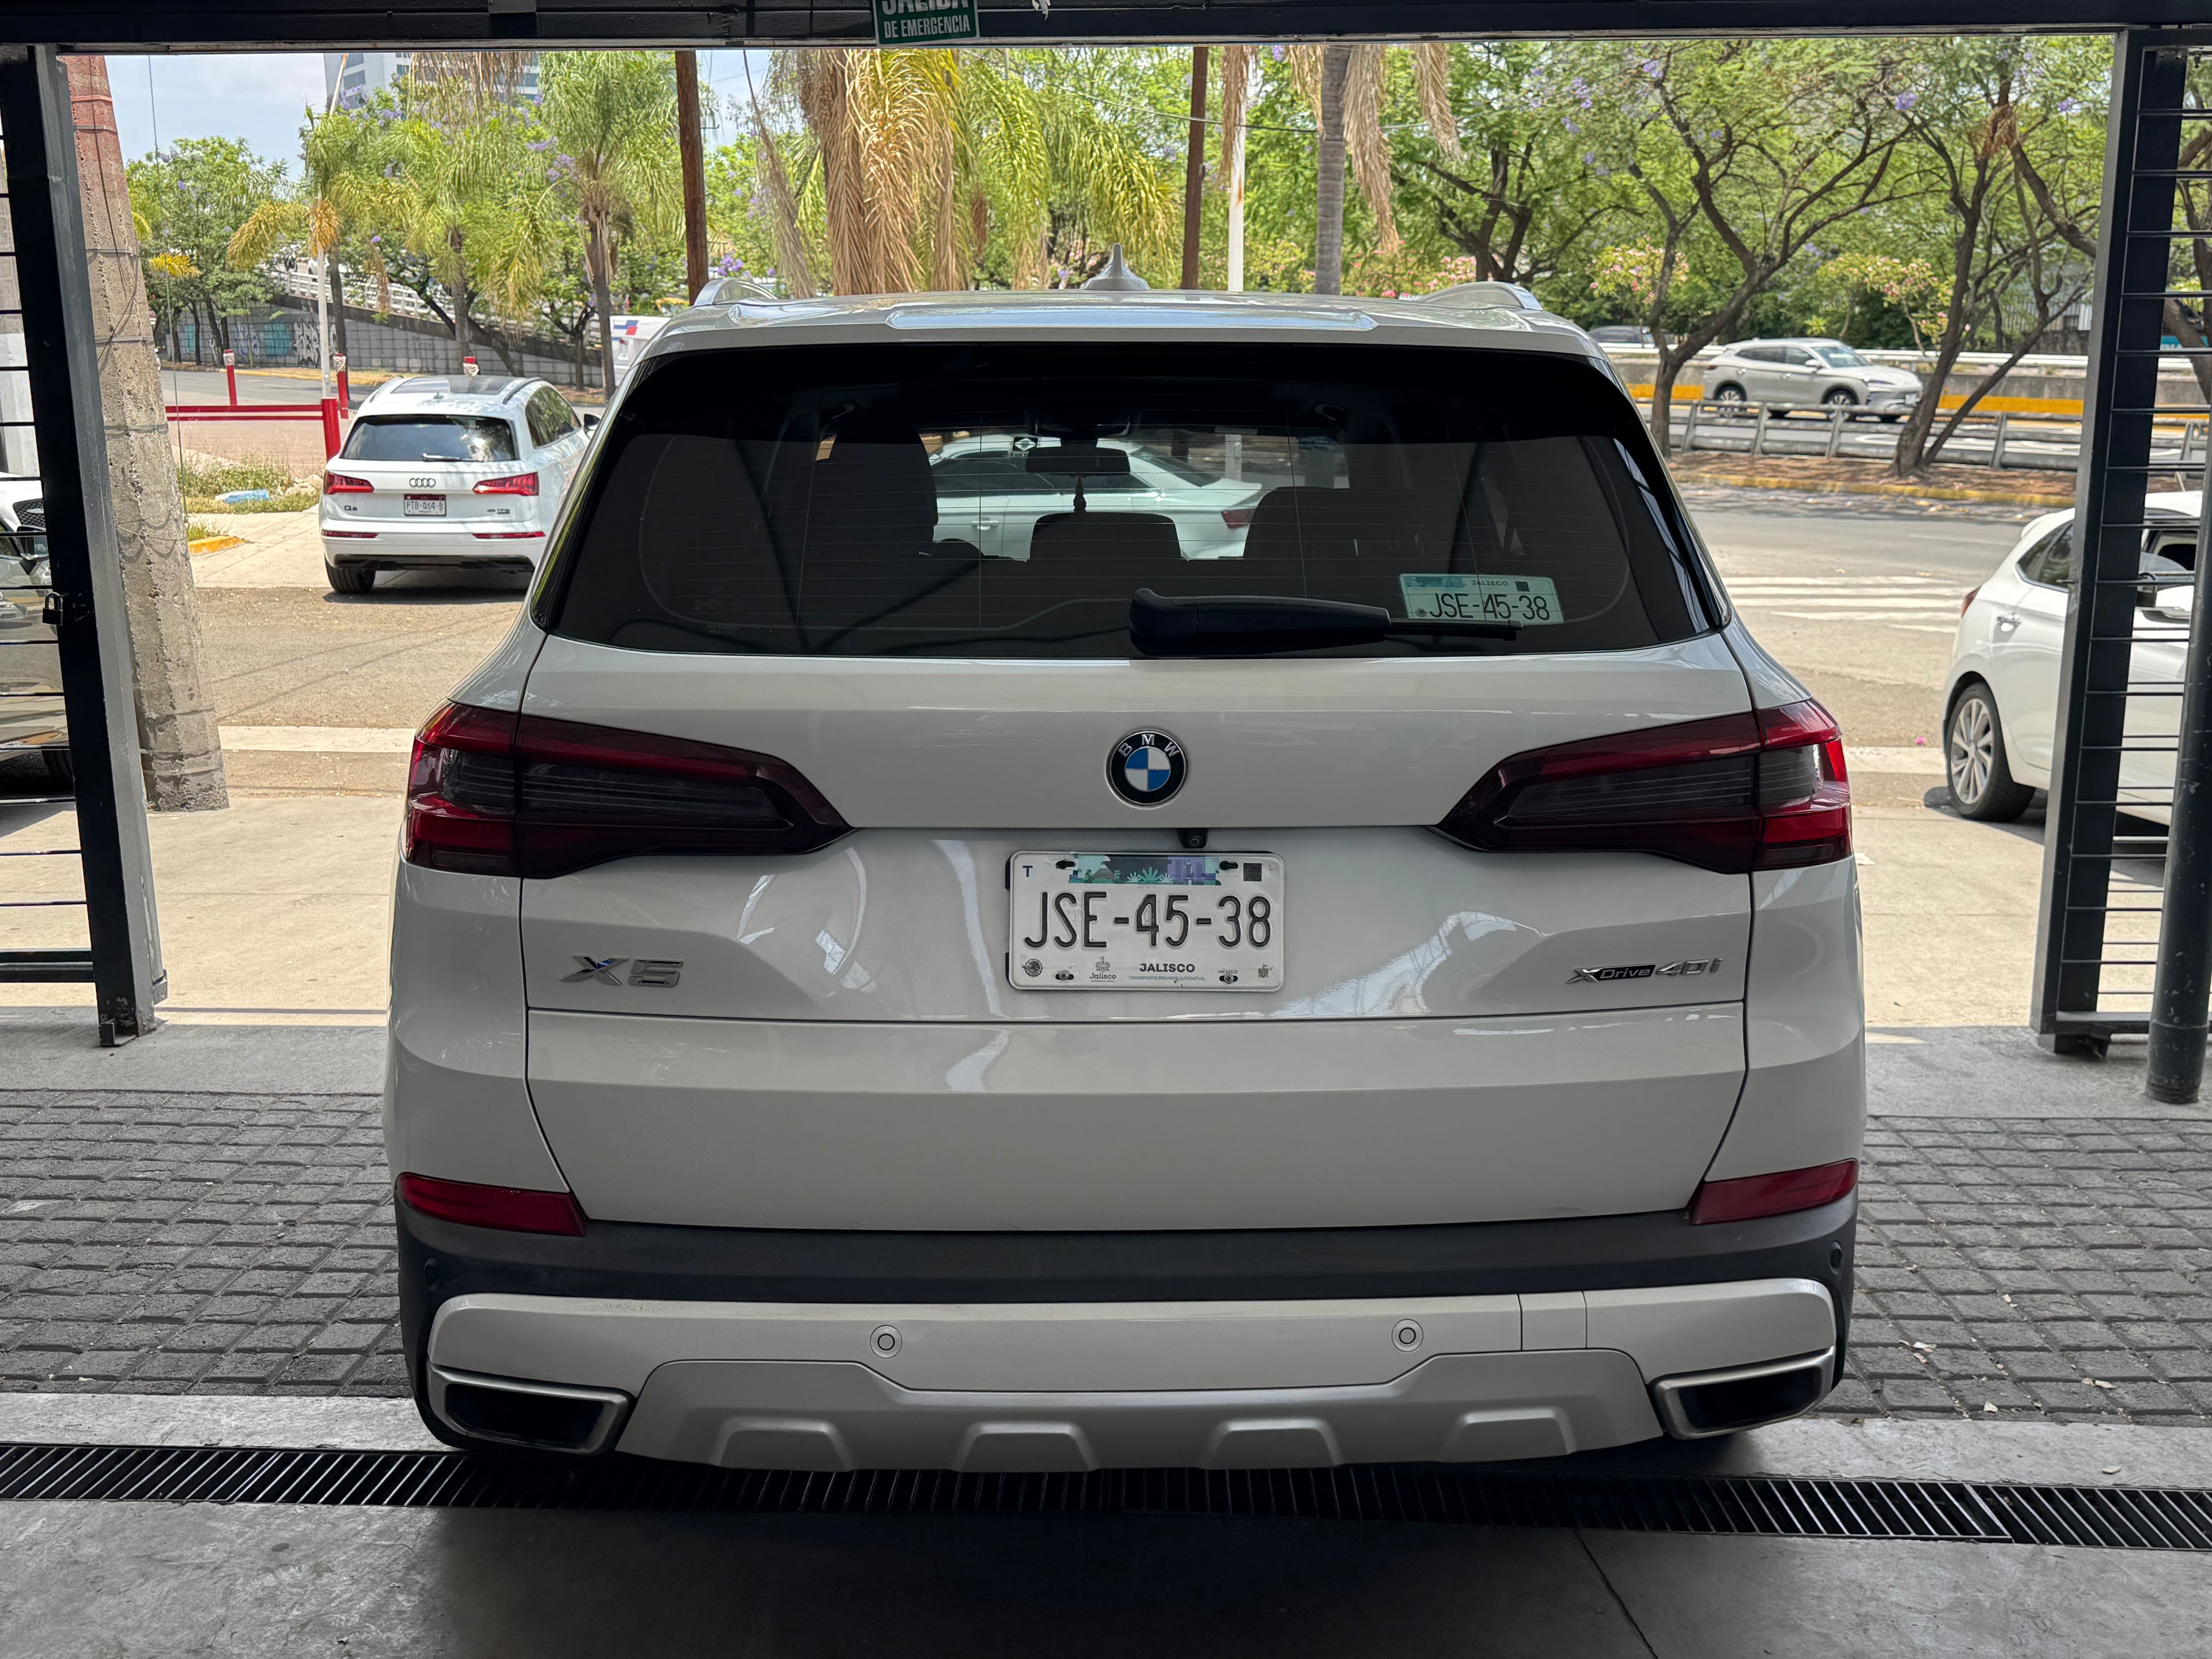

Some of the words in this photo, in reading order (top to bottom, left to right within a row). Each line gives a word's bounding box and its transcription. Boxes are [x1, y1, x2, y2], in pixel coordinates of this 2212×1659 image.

[884, 21, 898, 38] DE
[901, 15, 971, 37] EMERGENCIA
[1429, 593, 1550, 620] JSE-45-38
[1118, 734, 1179, 757] BMW
[1022, 865, 1033, 877] T
[1024, 892, 1271, 948] JSE-45-38
[558, 954, 684, 988] X5
[1139, 963, 1195, 972] JALISCO
